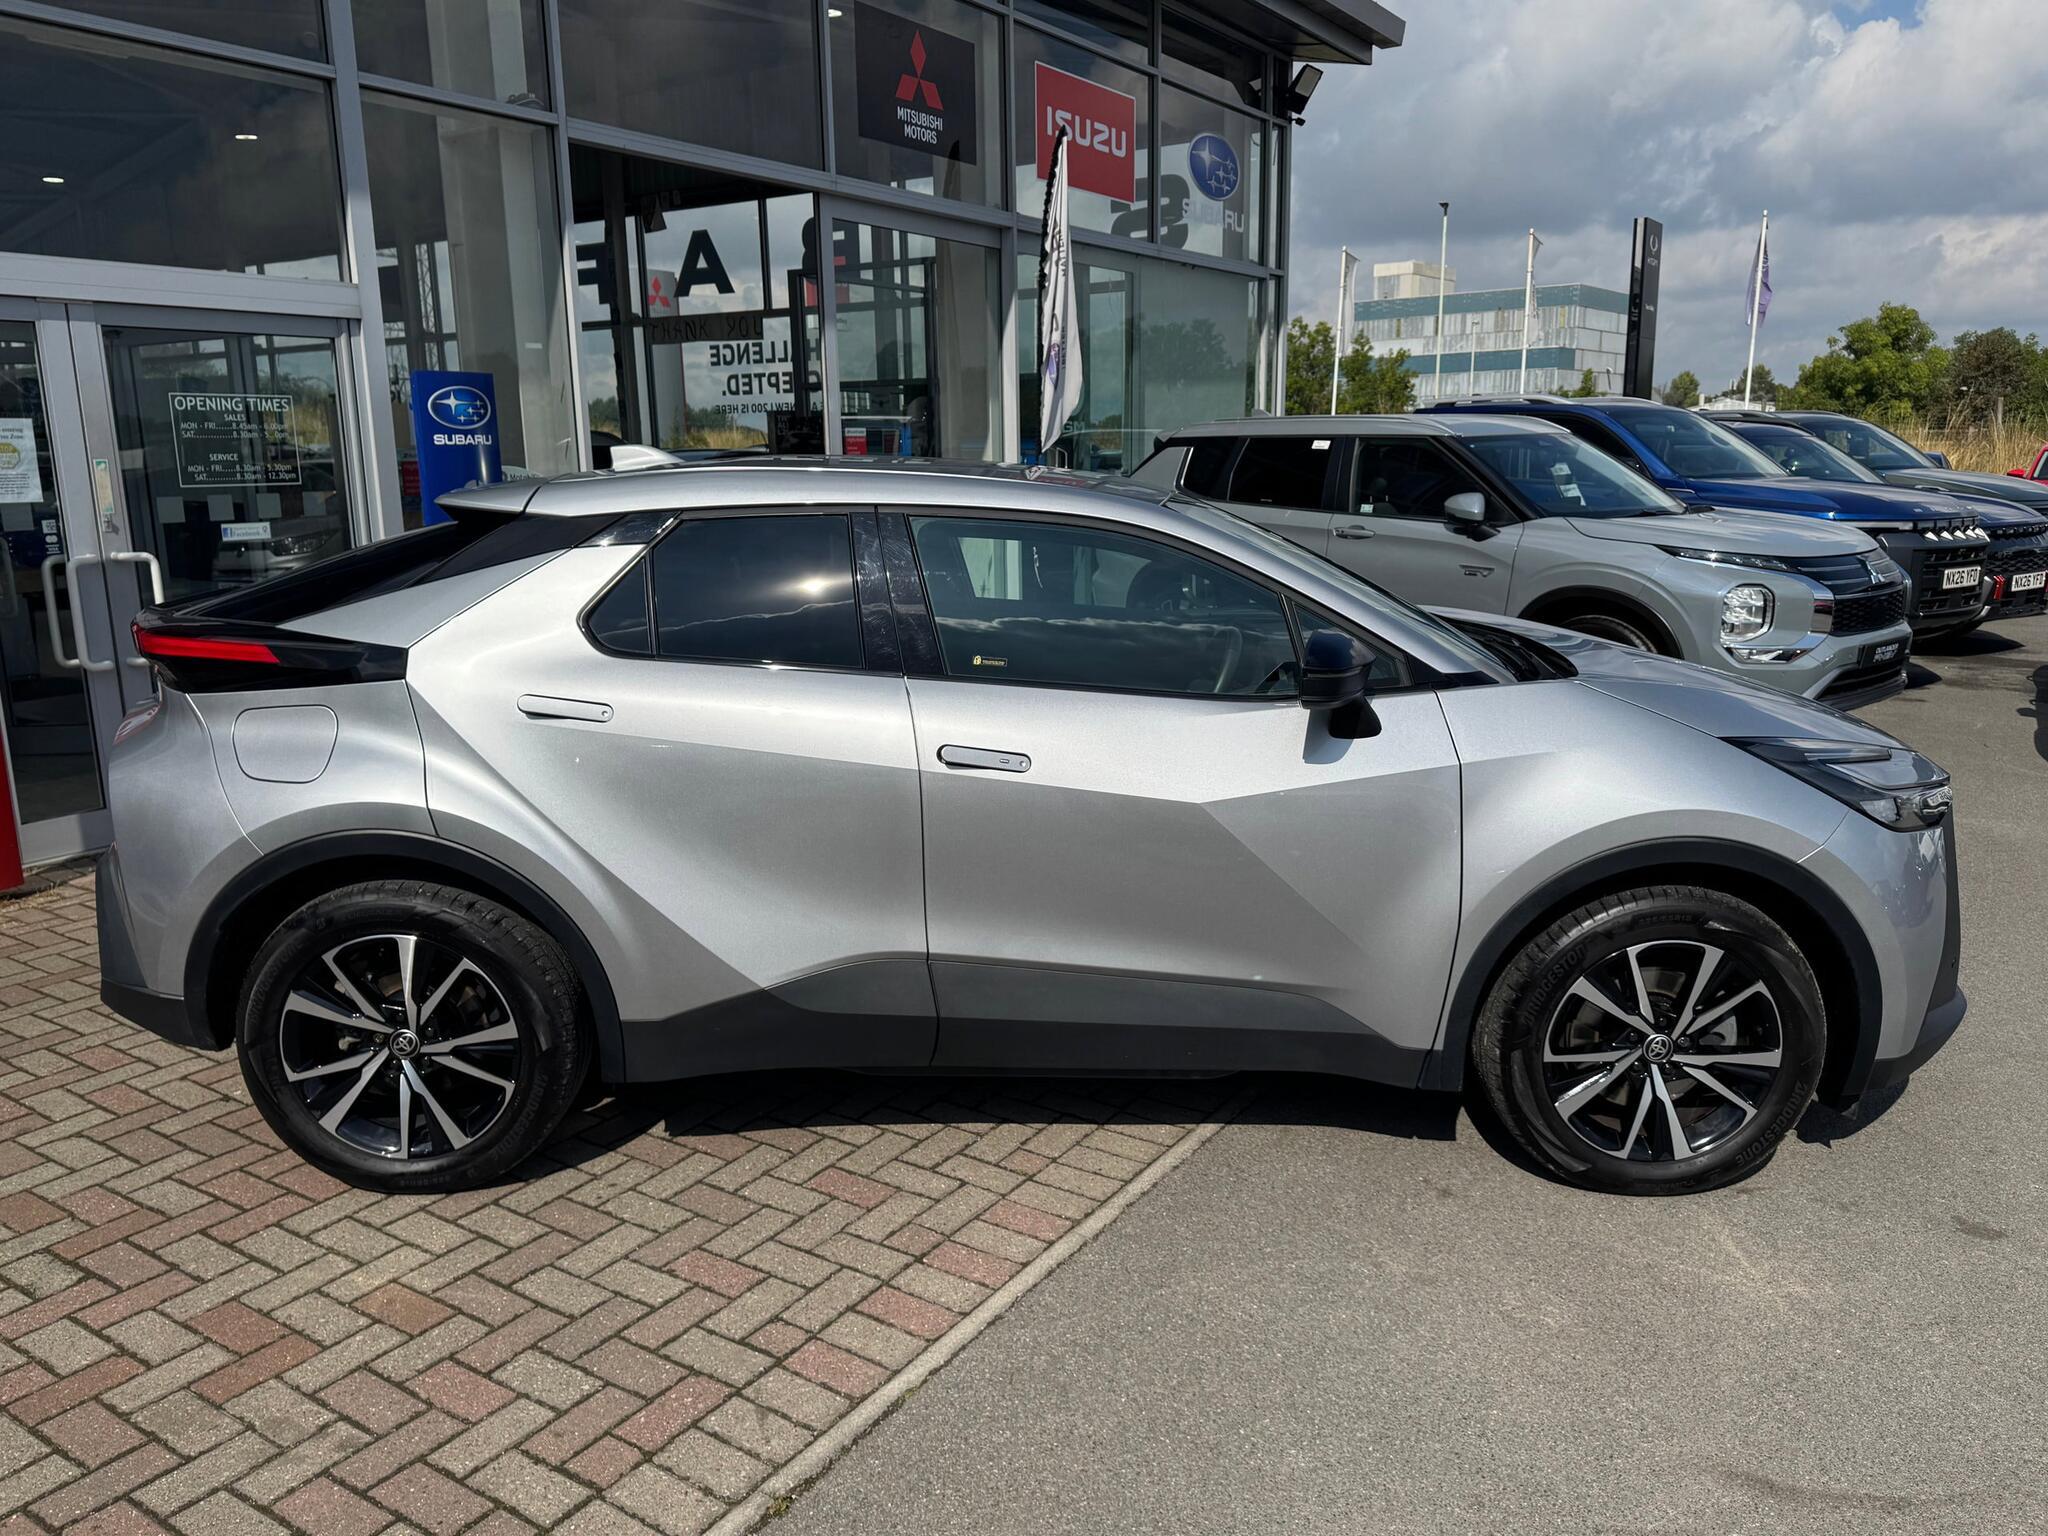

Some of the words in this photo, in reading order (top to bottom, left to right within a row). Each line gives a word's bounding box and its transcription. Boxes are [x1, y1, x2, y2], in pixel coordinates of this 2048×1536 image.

[896, 105, 943, 131] MITSUBISHI
[904, 124, 938, 144] MOTORS
[1046, 105, 1127, 158] ISUZU
[174, 396, 243, 411] OPENING
[246, 398, 289, 412] TIMES
[224, 413, 246, 421] SALES
[433, 433, 492, 446] SUBARU
[209, 453, 239, 461] SERVICE
[1945, 569, 1966, 586] NX26
[2014, 575, 2032, 589] NX26
[1734, 1079, 1809, 1167] BRIDGESTONE
